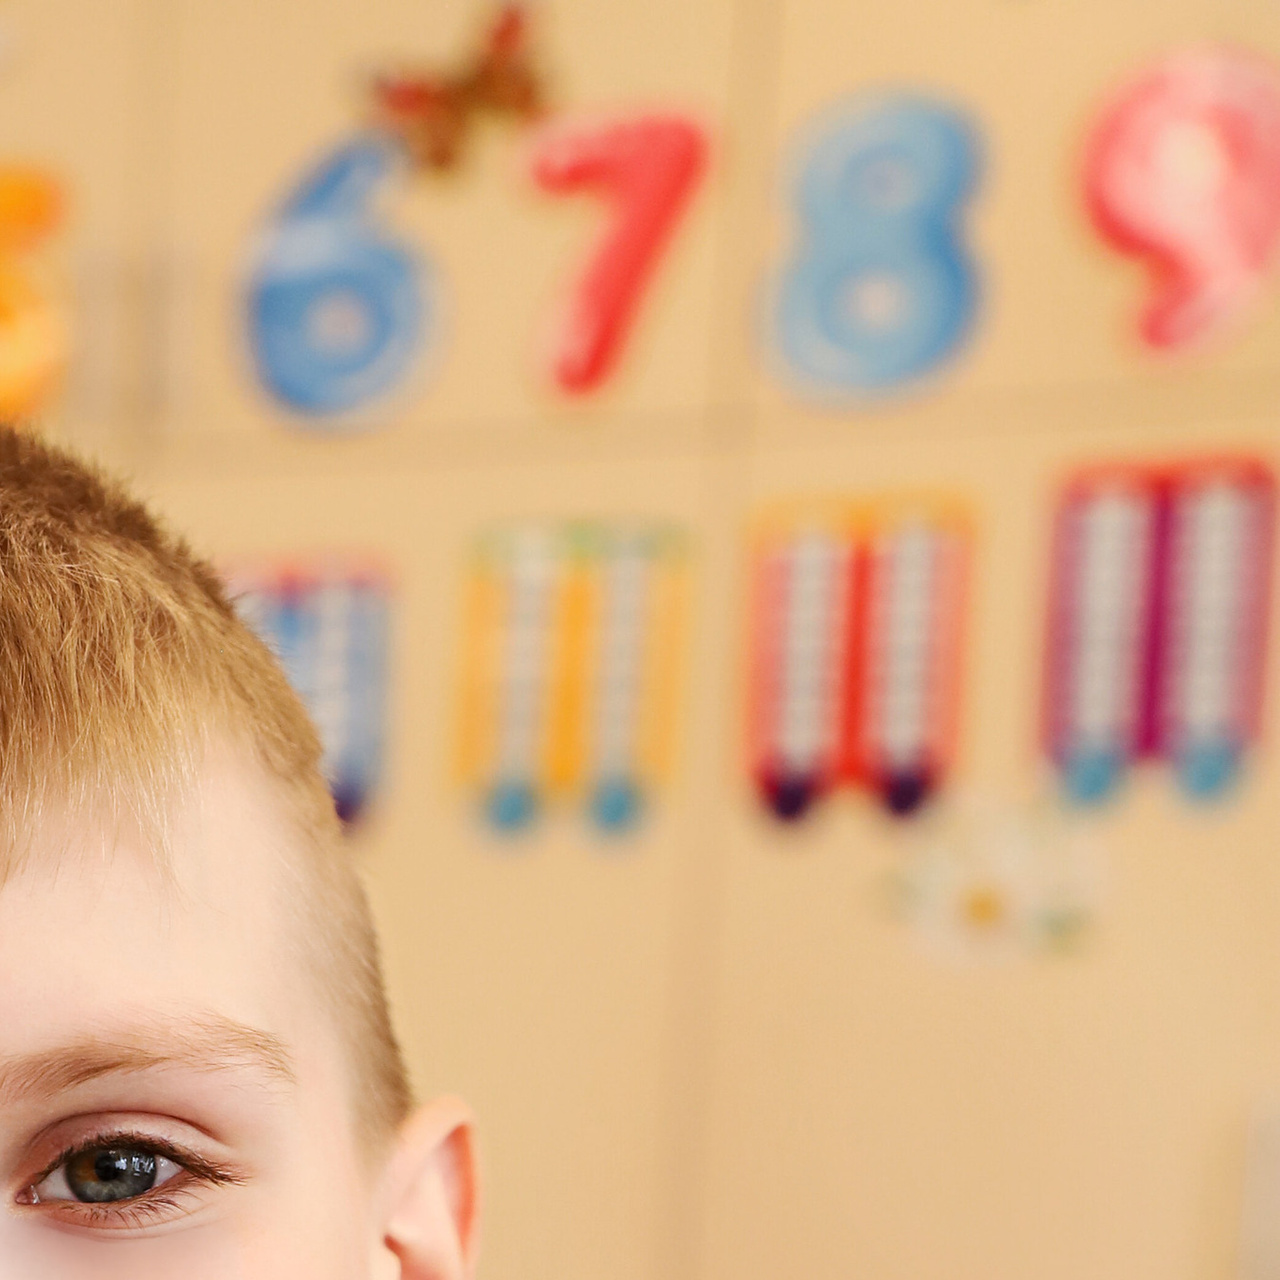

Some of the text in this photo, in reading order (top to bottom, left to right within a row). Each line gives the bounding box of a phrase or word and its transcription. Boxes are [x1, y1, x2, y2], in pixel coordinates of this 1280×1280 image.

[244, 132, 428, 418] 6
[530, 110, 712, 396] 7
[762, 84, 986, 406] 8
[1078, 46, 1280, 352] 9
